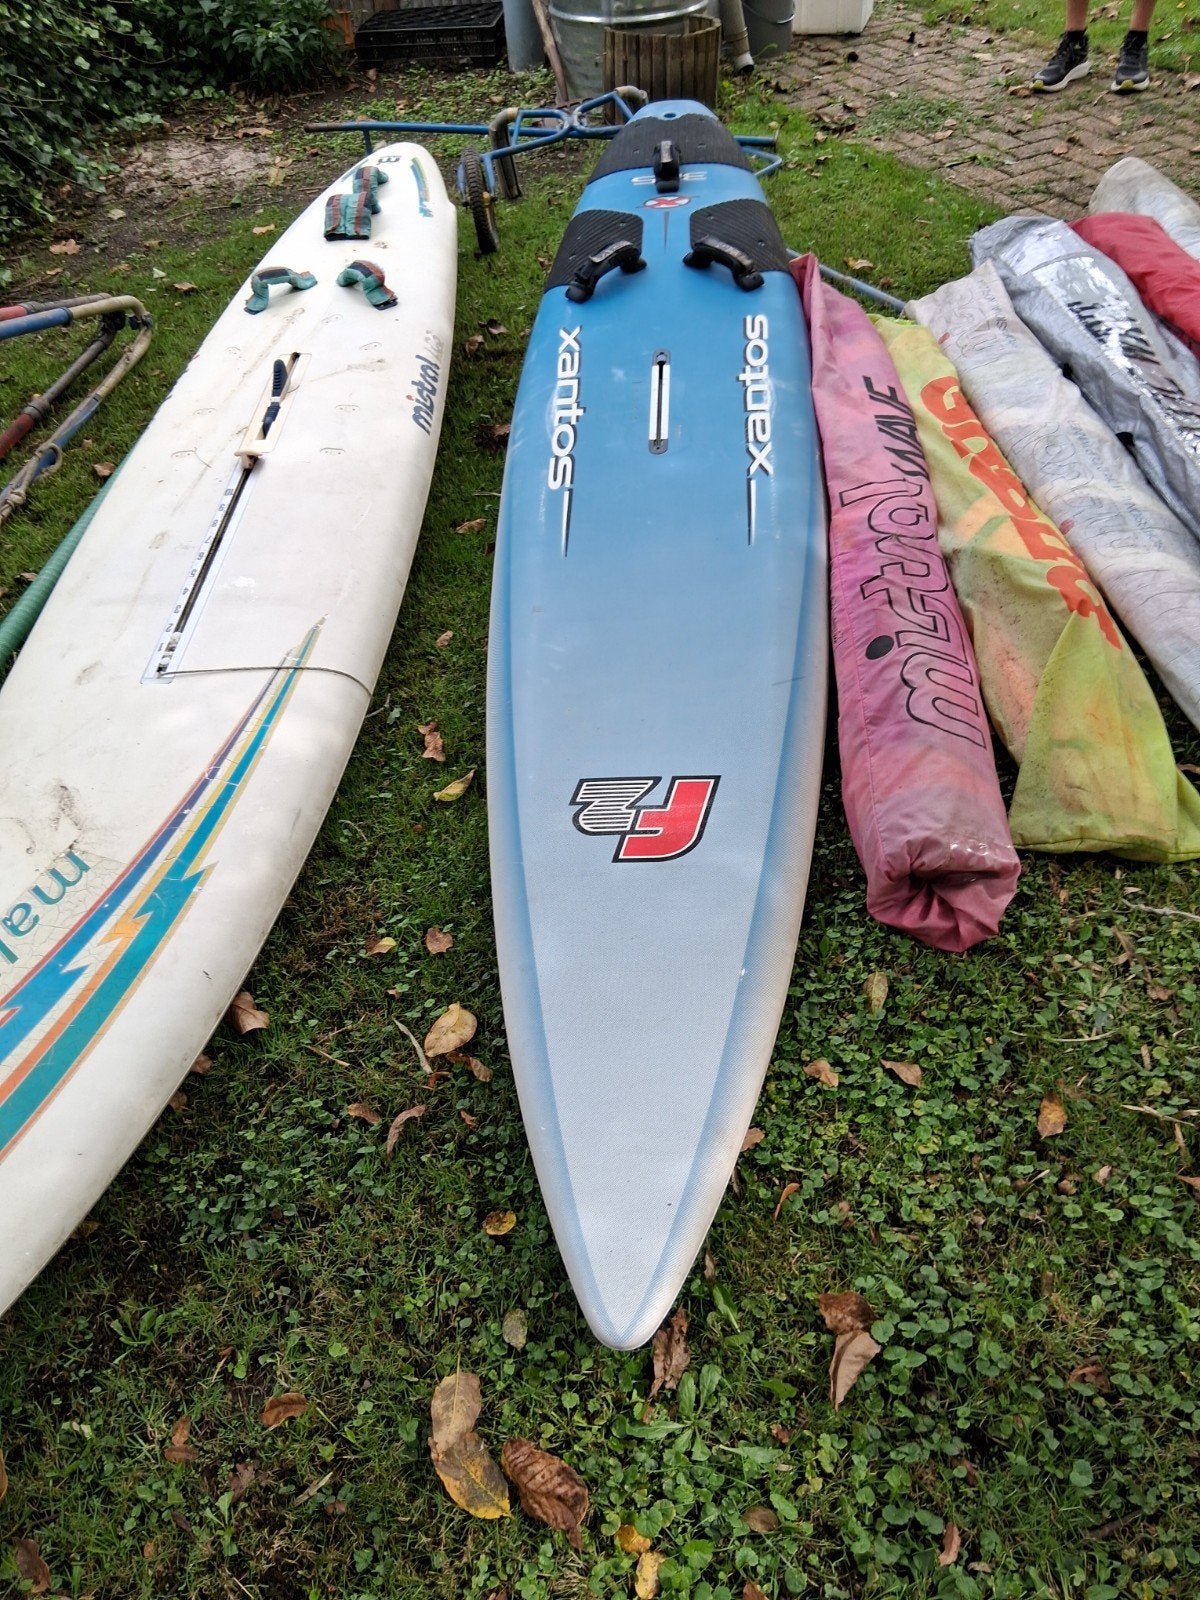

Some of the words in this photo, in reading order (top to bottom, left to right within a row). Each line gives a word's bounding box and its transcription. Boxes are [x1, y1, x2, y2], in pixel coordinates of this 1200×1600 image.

[406, 354, 440, 436] mistral
[548, 325, 585, 492] xantos
[737, 313, 774, 477] xantos
[839, 478, 987, 751] mistral
